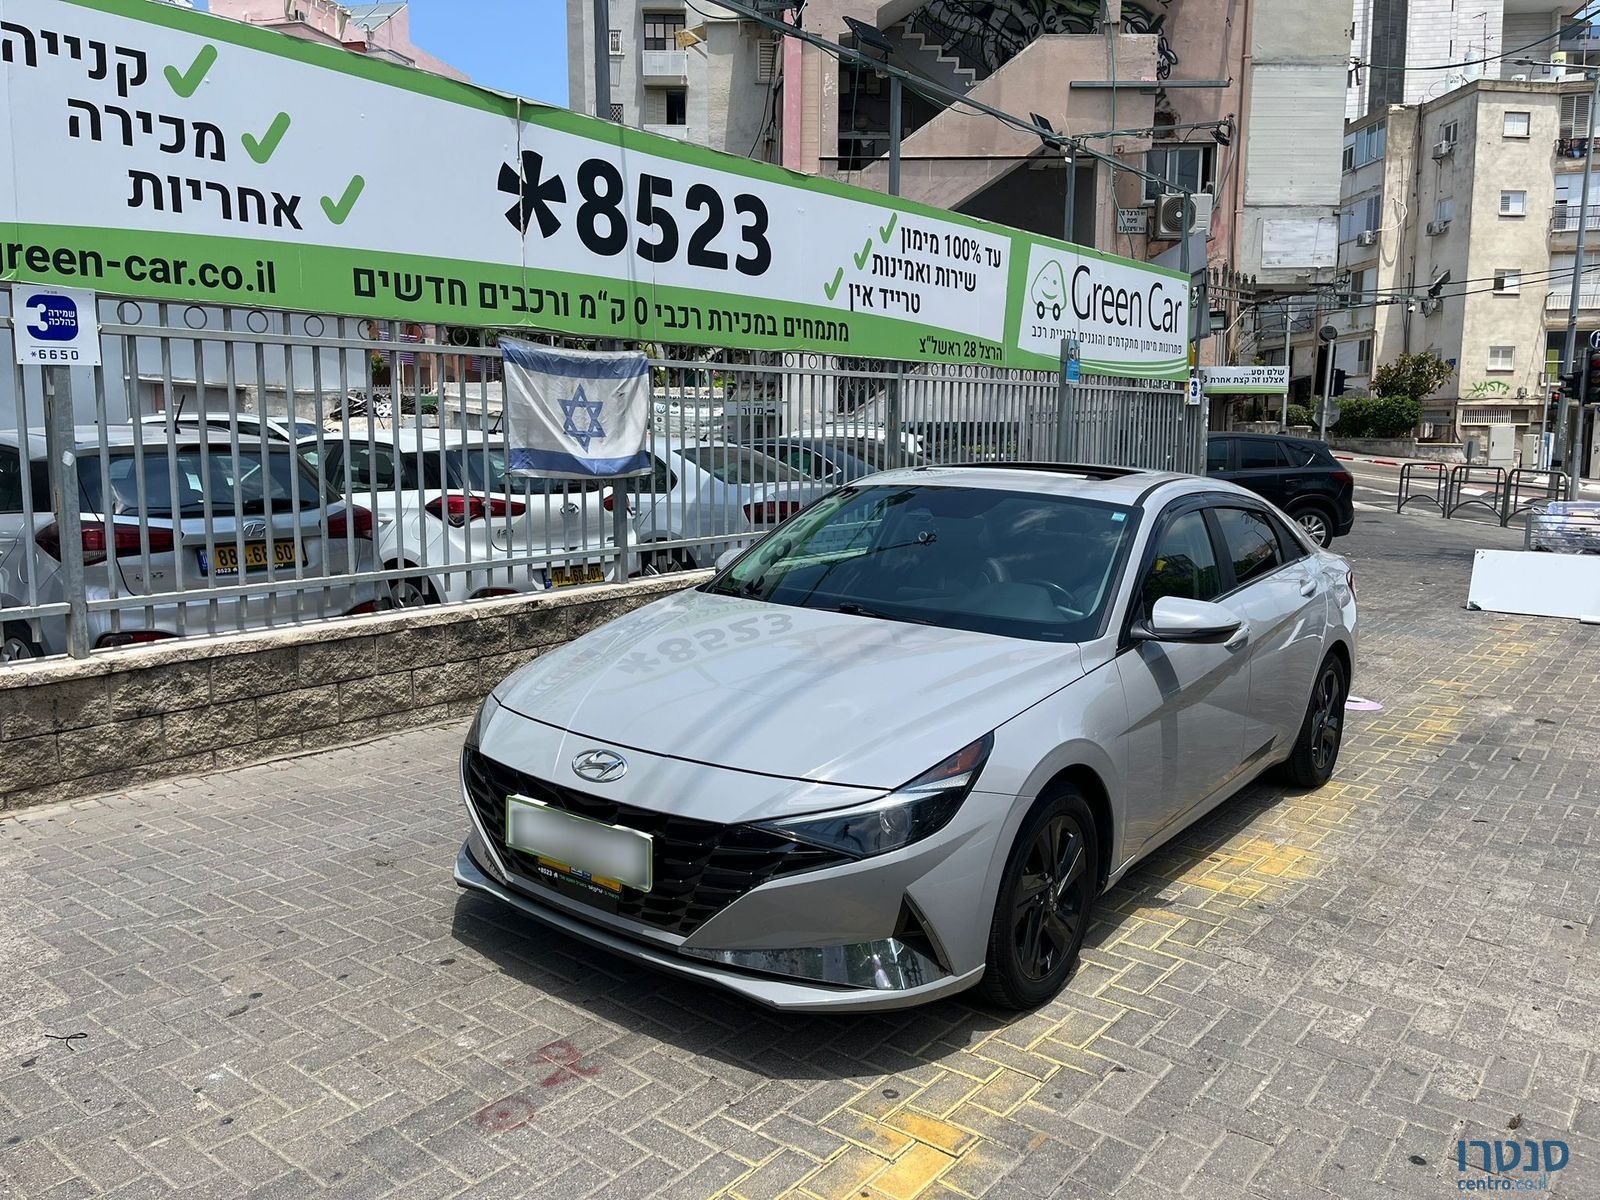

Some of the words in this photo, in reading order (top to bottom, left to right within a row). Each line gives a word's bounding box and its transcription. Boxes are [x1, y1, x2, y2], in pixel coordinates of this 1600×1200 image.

[1, 21, 147, 97] קנייה
[68, 98, 226, 162] מכירה
[127, 169, 304, 230] אחריות
[901, 226, 939, 254] מימון
[945, 234, 981, 264] 100%
[0, 241, 276, 294] reen-car.co.il
[872, 253, 930, 284] ואמינות
[985, 247, 1001, 268] עד
[353, 267, 467, 307] חדשים
[935, 266, 976, 292] שירות
[479, 281, 569, 317] ורכבים
[849, 283, 873, 312] אין
[879, 287, 920, 313] טרייד
[1072, 264, 1142, 328] Green
[1148, 282, 1182, 334] Car
[48, 309, 76, 318] שמירה
[48, 318, 76, 327] כהלכה
[655, 303, 701, 330] רכבי
[708, 309, 778, 336] במכירת
[783, 316, 849, 342] מתמחים
[1031, 325, 1047, 339] רכב
[1079, 331, 1106, 346] והוגנים
[963, 340, 977, 358] 28
[979, 341, 1003, 361] הרצל
[1107, 335, 1139, 351] מתקדמים
[1140, 339, 1157, 353] מימון
[1158, 342, 1182, 355] פתרונות
[1210, 376, 1232, 384] אחרת
[1232, 376, 1250, 385] קצת
[1251, 376, 1261, 384] זה
[1262, 375, 1285, 384] אצלנו
[1267, 368, 1285, 376] שלם
